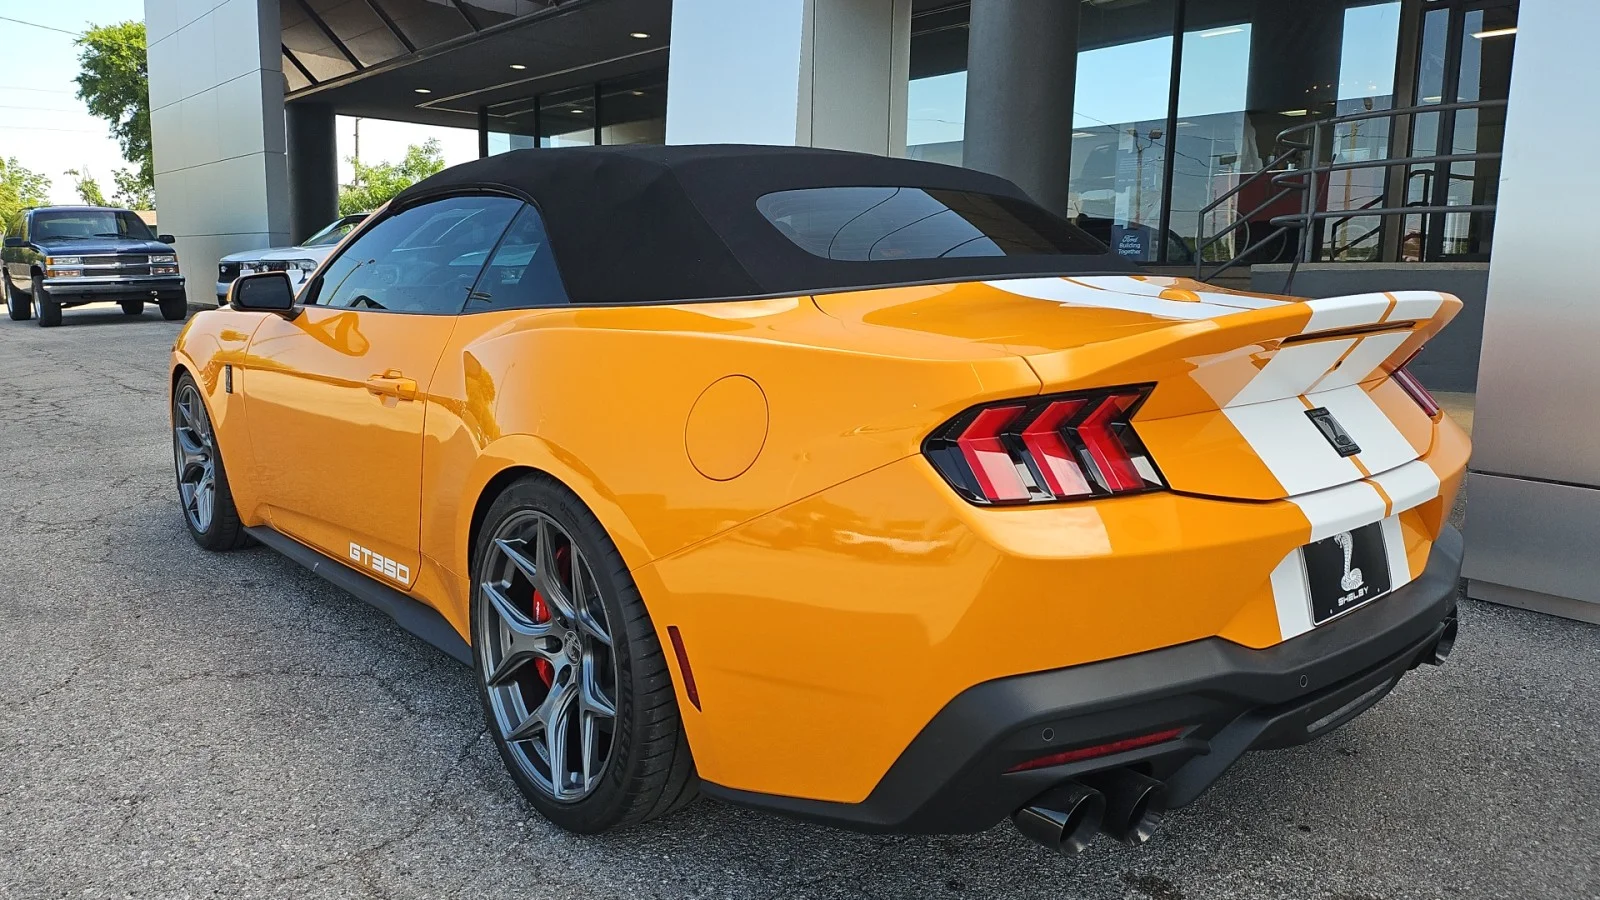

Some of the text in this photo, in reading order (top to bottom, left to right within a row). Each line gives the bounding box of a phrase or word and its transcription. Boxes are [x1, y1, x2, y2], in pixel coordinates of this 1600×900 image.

[1122, 234, 1139, 242] Ford
[349, 541, 410, 585] GT350
[1338, 586, 1369, 606] SHELBY
